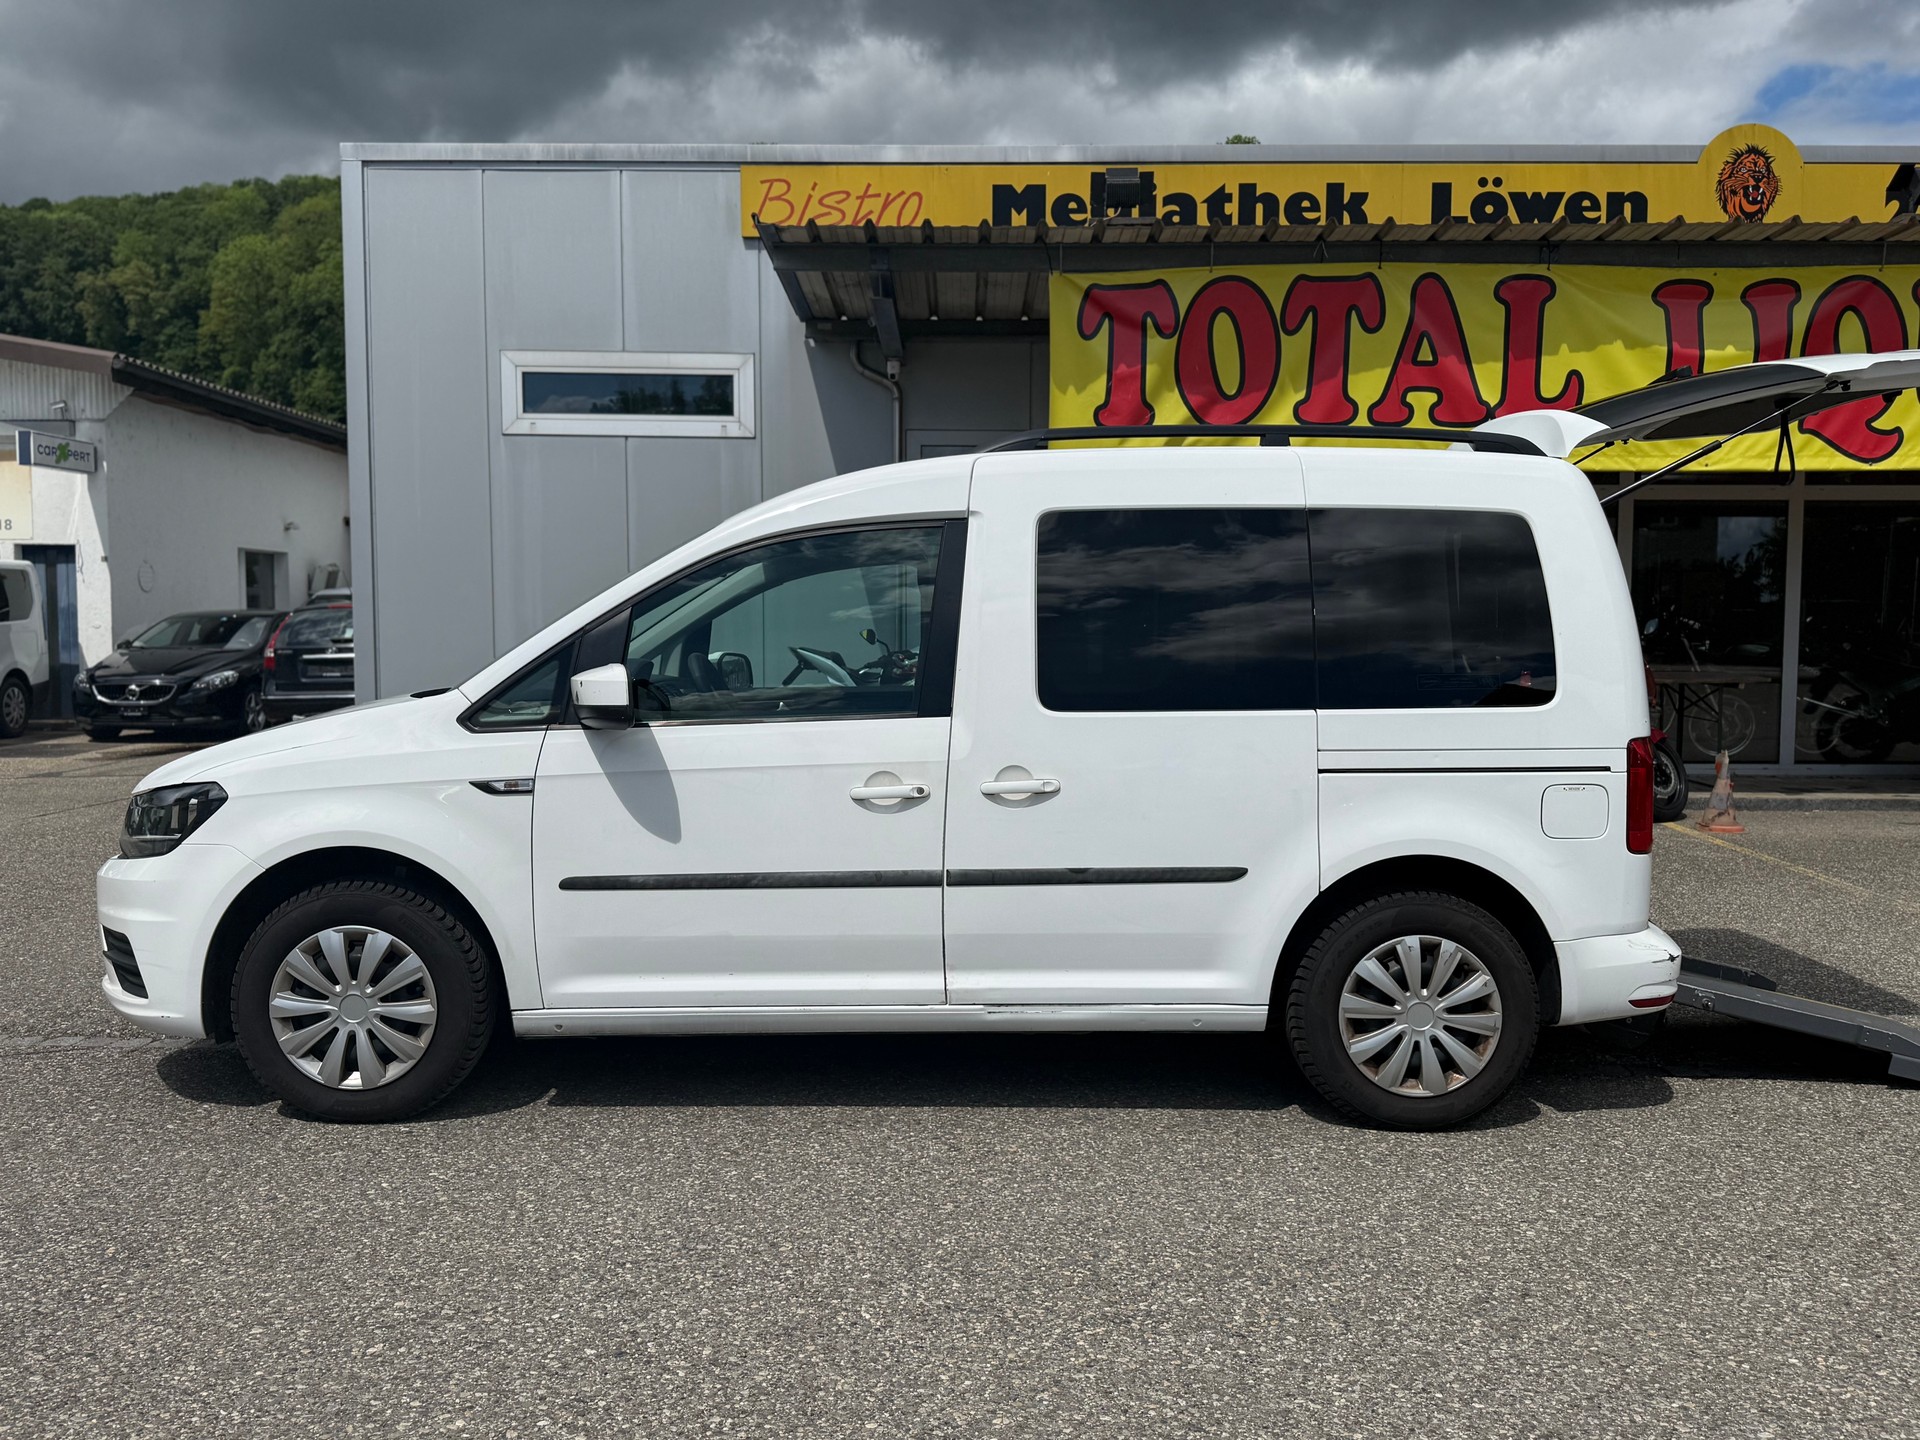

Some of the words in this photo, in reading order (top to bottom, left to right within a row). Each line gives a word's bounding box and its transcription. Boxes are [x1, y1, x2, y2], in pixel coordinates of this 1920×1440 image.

[753, 178, 923, 227] Bistro
[992, 182, 1369, 227] Meathek
[1431, 176, 1649, 224] Löwen
[1077, 271, 1584, 426] TOTAL
[1651, 274, 1920, 464] IQ
